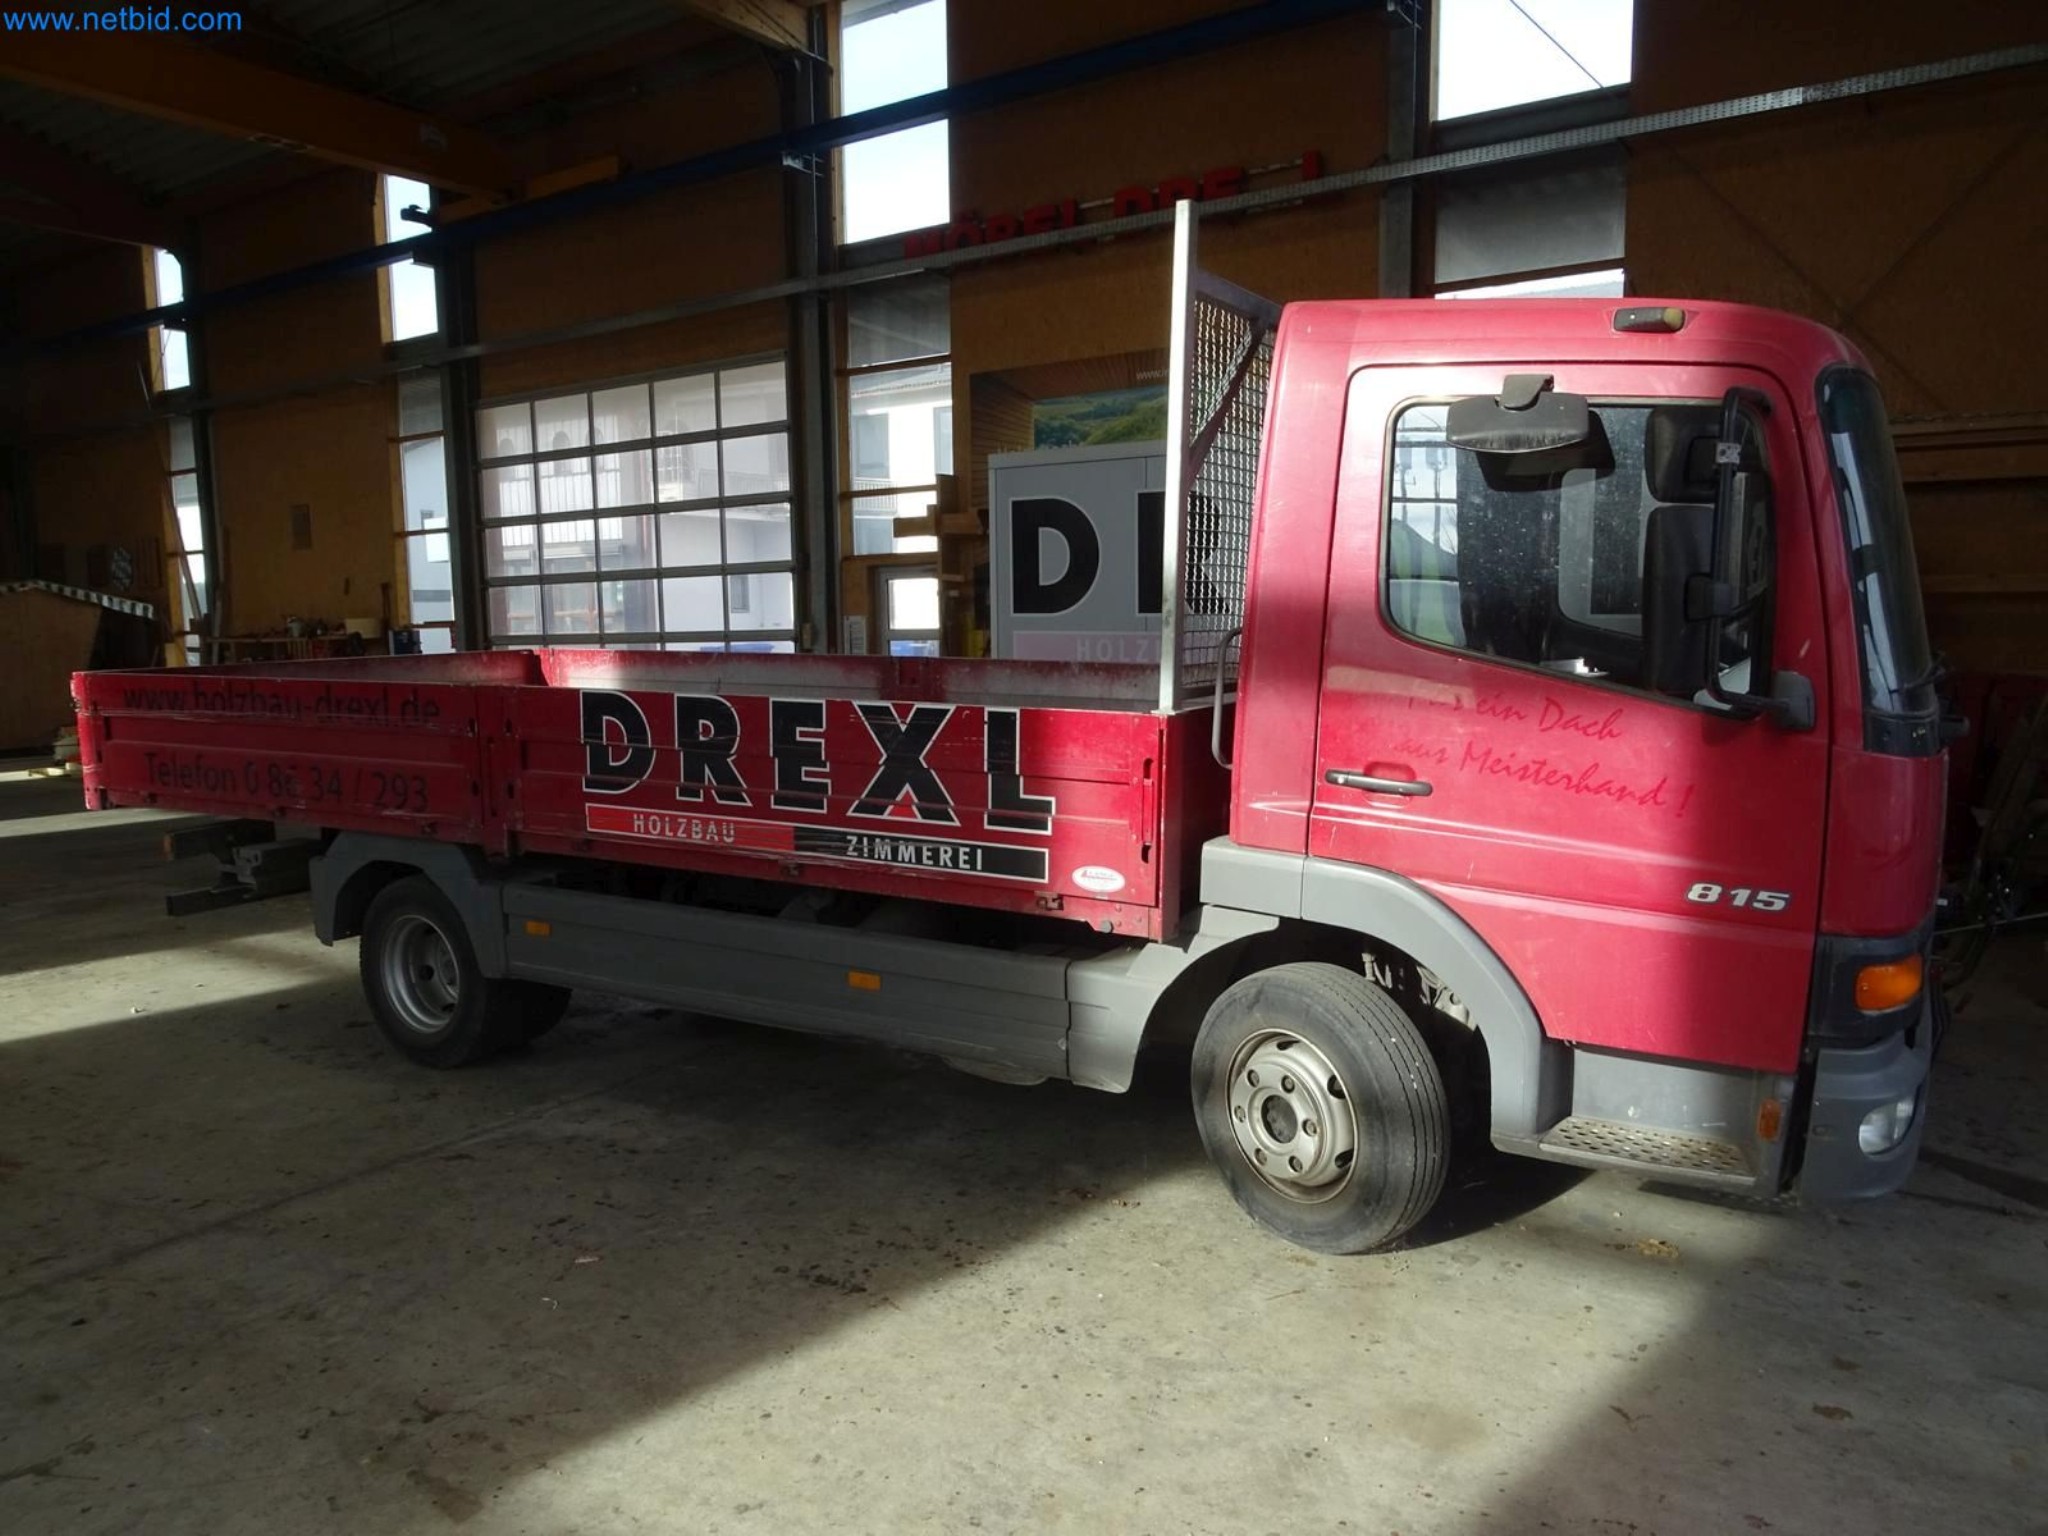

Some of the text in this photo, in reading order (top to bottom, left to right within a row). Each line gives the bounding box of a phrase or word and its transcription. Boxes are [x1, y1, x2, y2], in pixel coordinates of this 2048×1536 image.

[1538, 696, 1624, 739] Dach
[145, 752, 237, 796] Telefon
[372, 770, 427, 813] 293
[579, 688, 1056, 835] DREXL
[632, 813, 984, 872] HOLZBAU ZIMMEREI
[1686, 882, 1790, 911] 815
